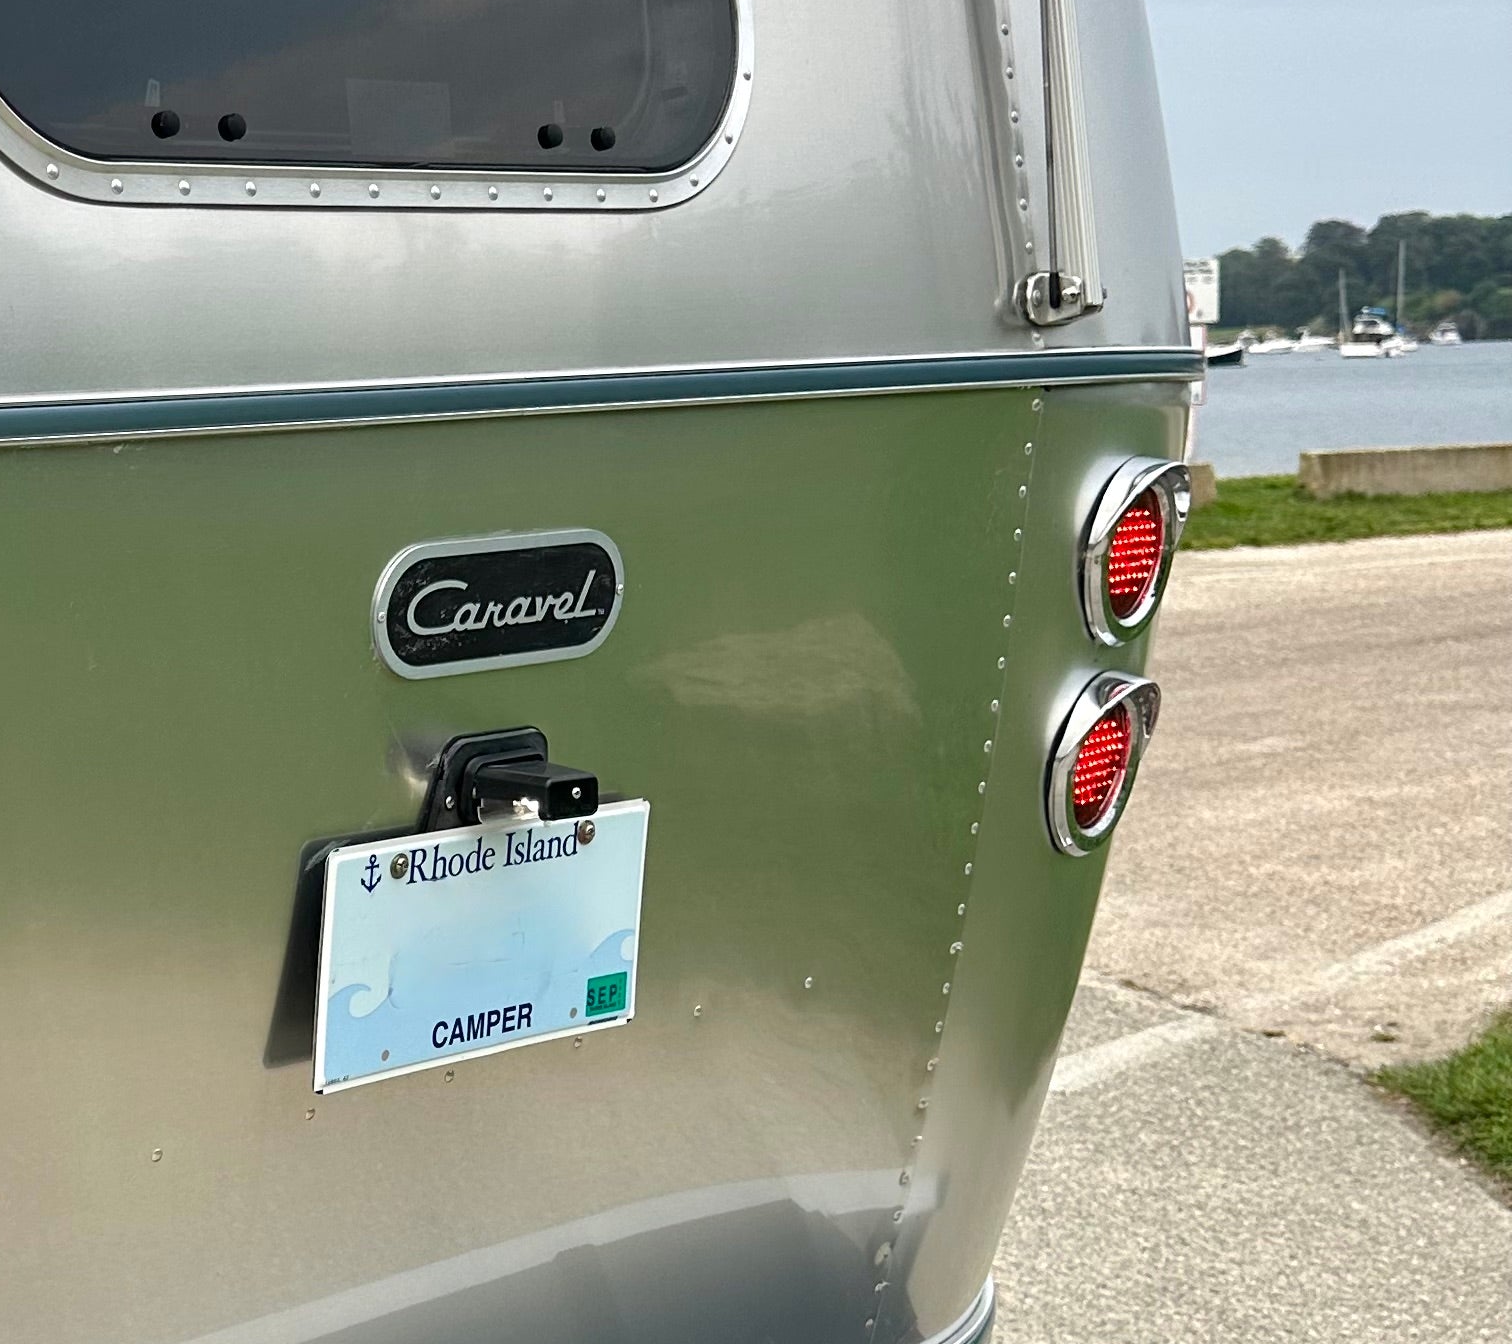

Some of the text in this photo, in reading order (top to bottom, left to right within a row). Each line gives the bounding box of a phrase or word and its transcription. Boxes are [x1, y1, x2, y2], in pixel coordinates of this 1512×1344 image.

[407, 569, 596, 636] Caravel
[406, 821, 580, 885] Rhode Island
[586, 984, 617, 1007] SEP
[432, 1002, 533, 1049] CAMPER
